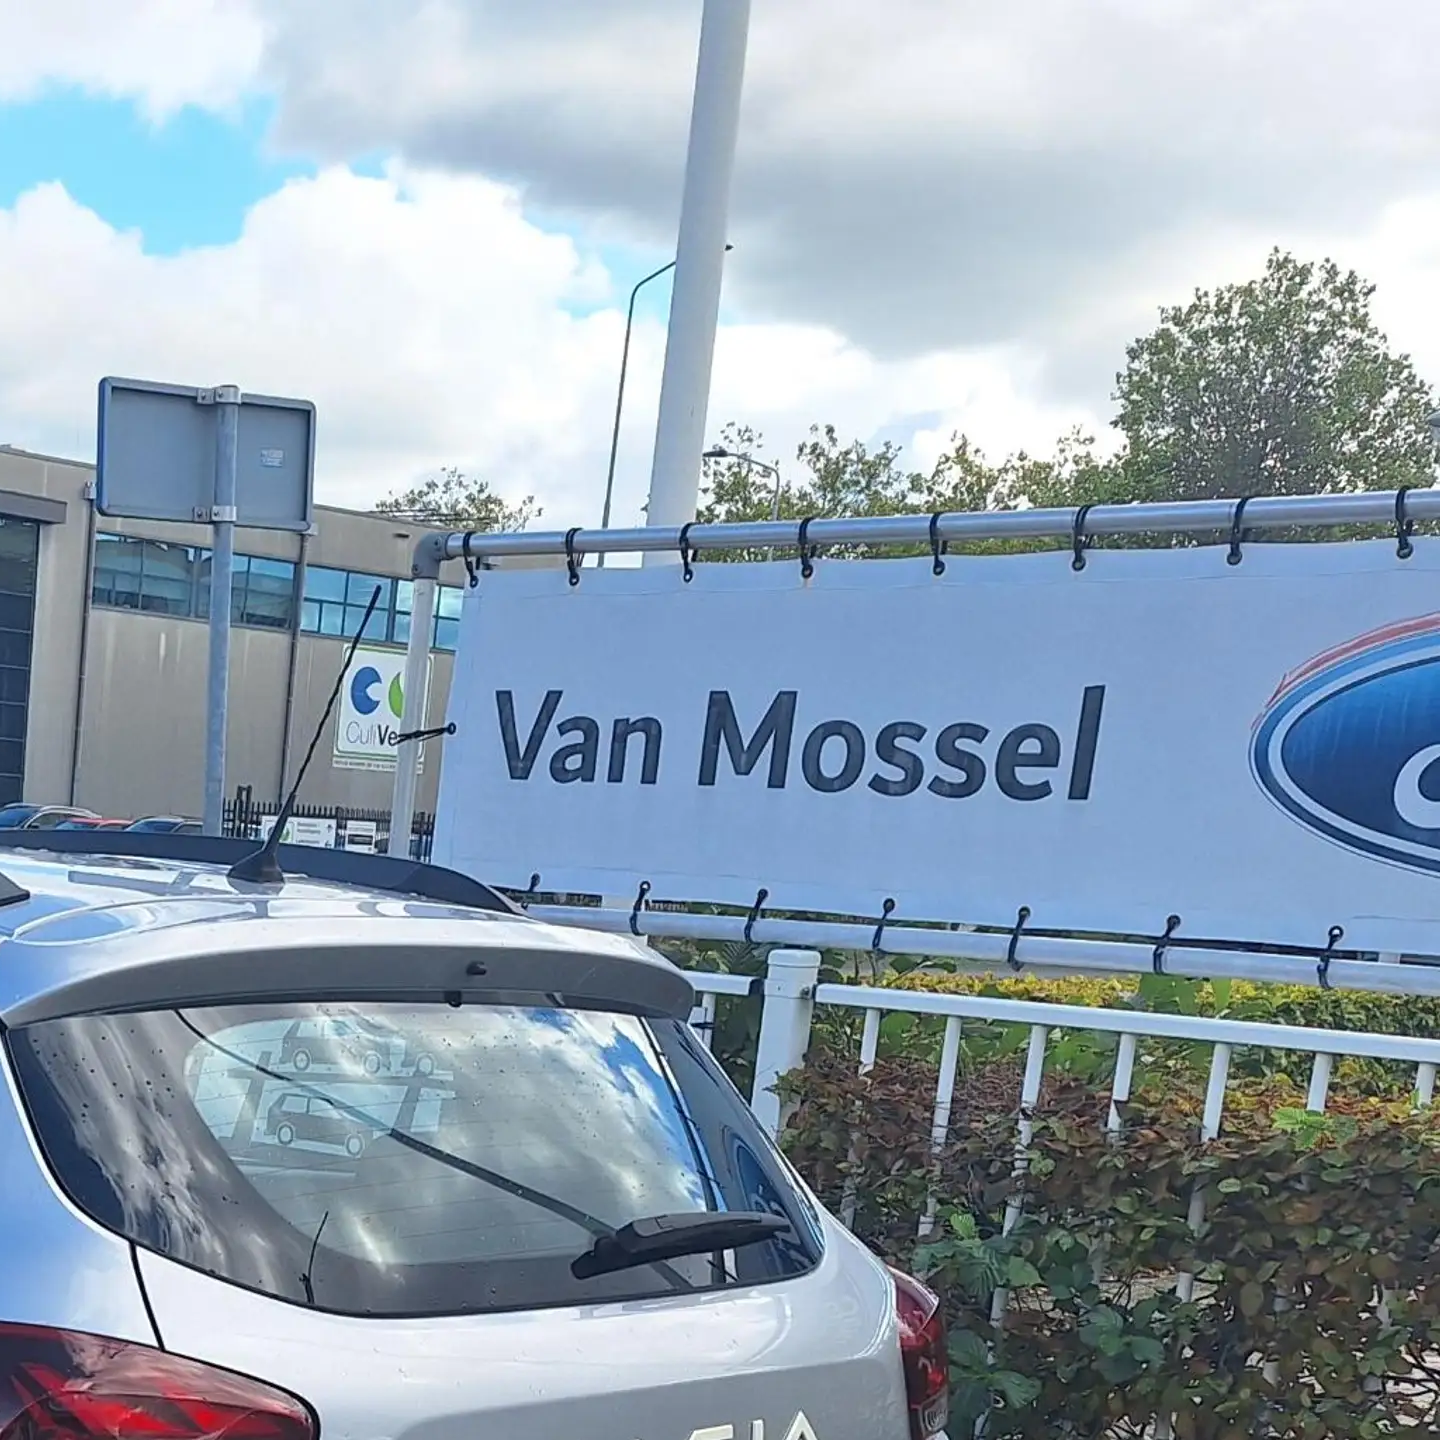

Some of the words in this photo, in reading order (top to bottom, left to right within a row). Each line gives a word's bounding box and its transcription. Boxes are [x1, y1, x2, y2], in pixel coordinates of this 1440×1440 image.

[346, 721, 398, 747] CuliVe
[494, 689, 662, 784] Van
[698, 684, 1106, 801] Mossel
